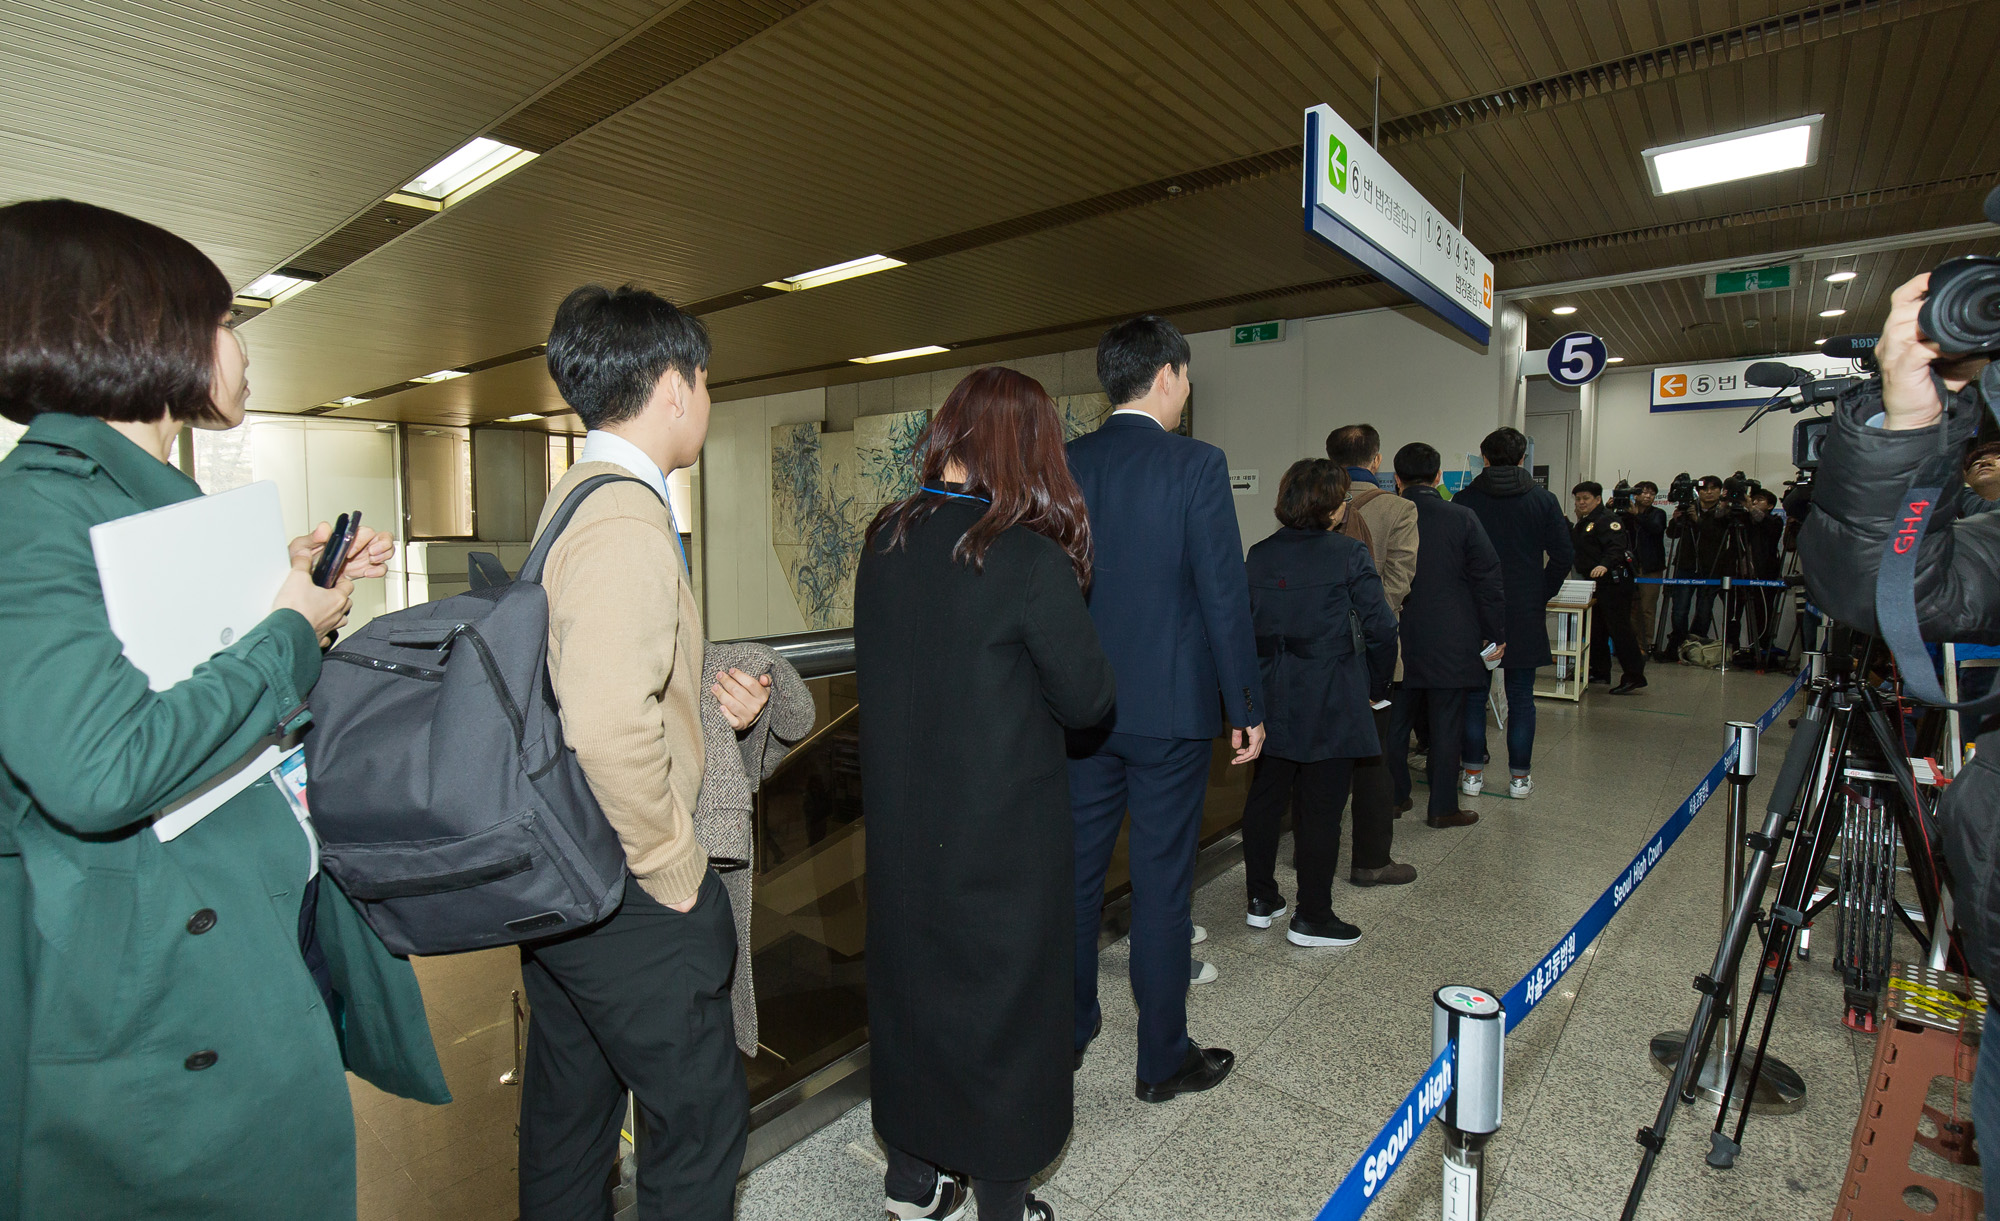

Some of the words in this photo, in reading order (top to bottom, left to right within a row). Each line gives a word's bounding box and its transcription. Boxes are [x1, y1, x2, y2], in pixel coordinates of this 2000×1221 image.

[1376, 186, 1417, 238] 법정출입구
[1456, 273, 1482, 309] 법정출입구
[1560, 337, 1593, 380] 5
[1893, 499, 1930, 554] GH4
[1614, 870, 1632, 907] Seoul
[1633, 855, 1647, 884] High
[1648, 837, 1663, 866] Court
[1525, 932, 1576, 1005] 서울고등법원
[1363, 1105, 1413, 1197] Seoul
[1418, 1060, 1452, 1124] High
